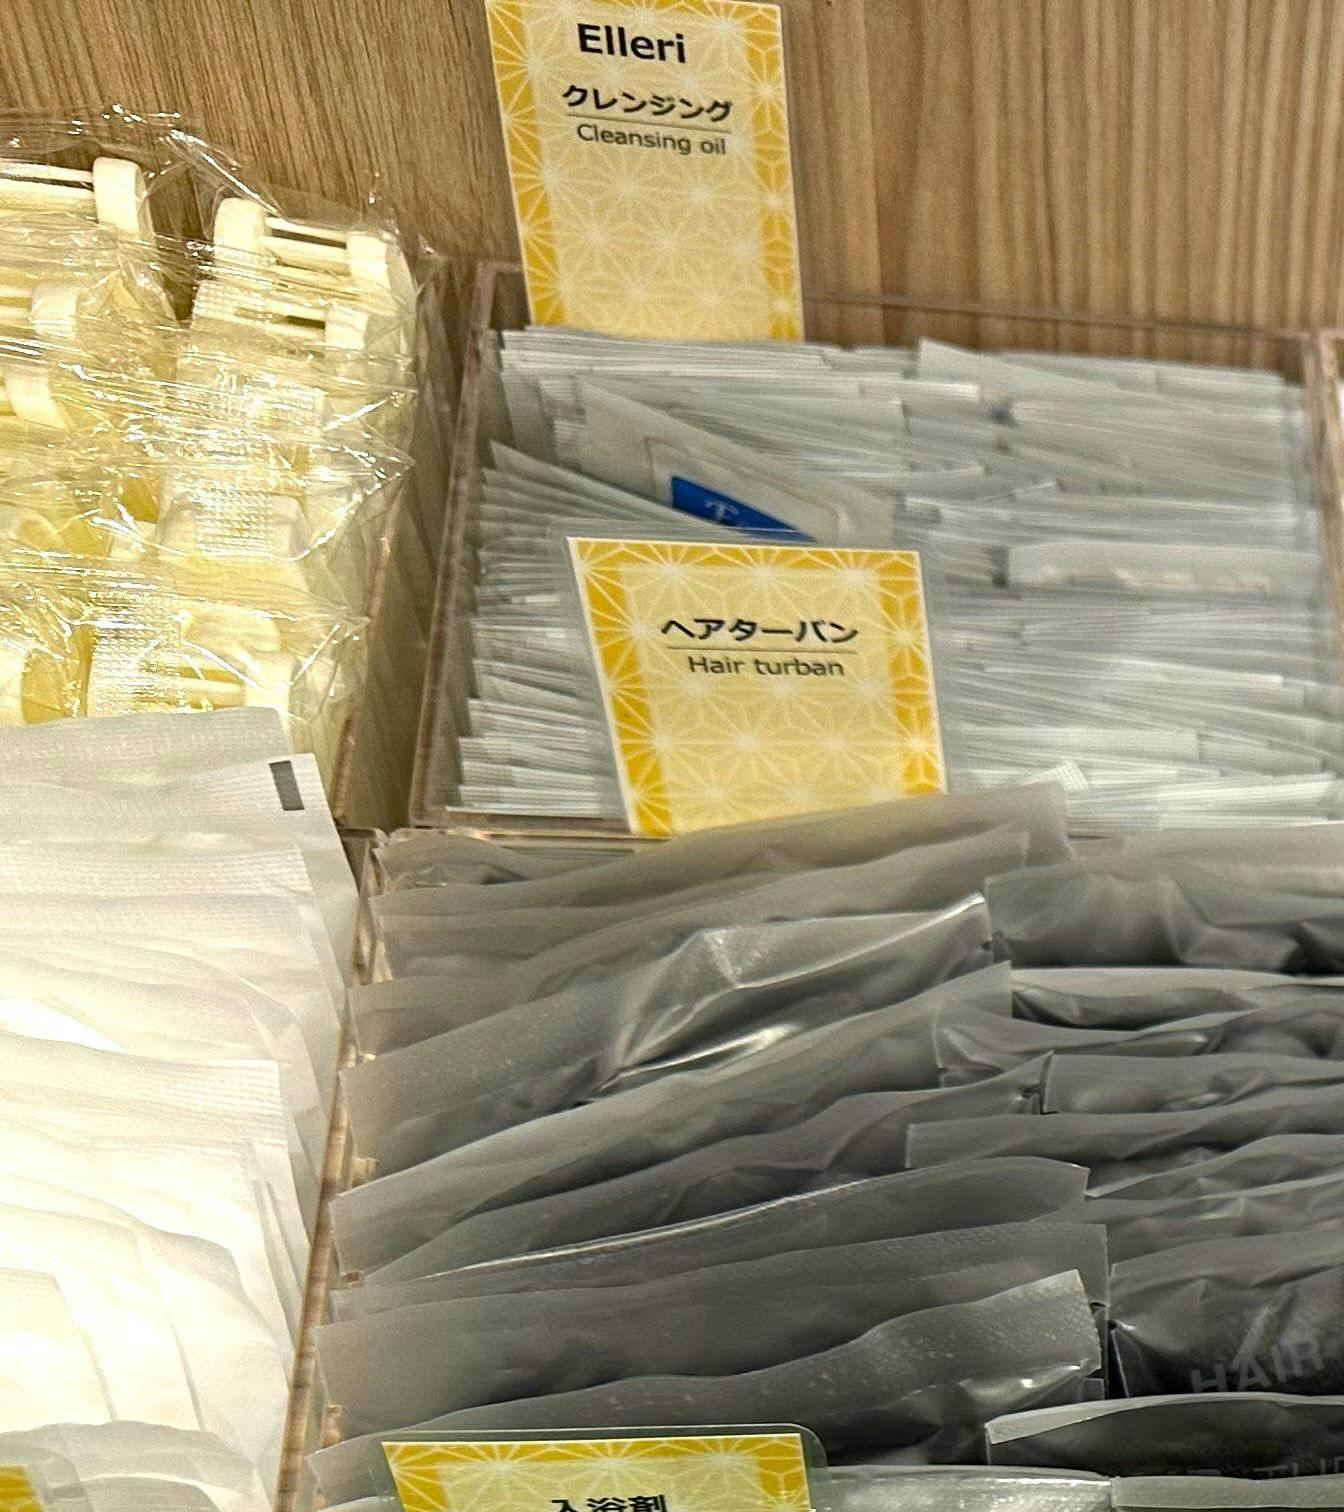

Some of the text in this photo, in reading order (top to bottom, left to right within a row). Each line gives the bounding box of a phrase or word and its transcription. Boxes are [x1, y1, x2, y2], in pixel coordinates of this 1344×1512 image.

[577, 23, 687, 63] Elleri
[562, 84, 733, 122] クレンジング
[576, 124, 727, 155] Cleansing oil
[660, 616, 859, 645] ヘアターバン
[688, 653, 845, 678] Hair turban
